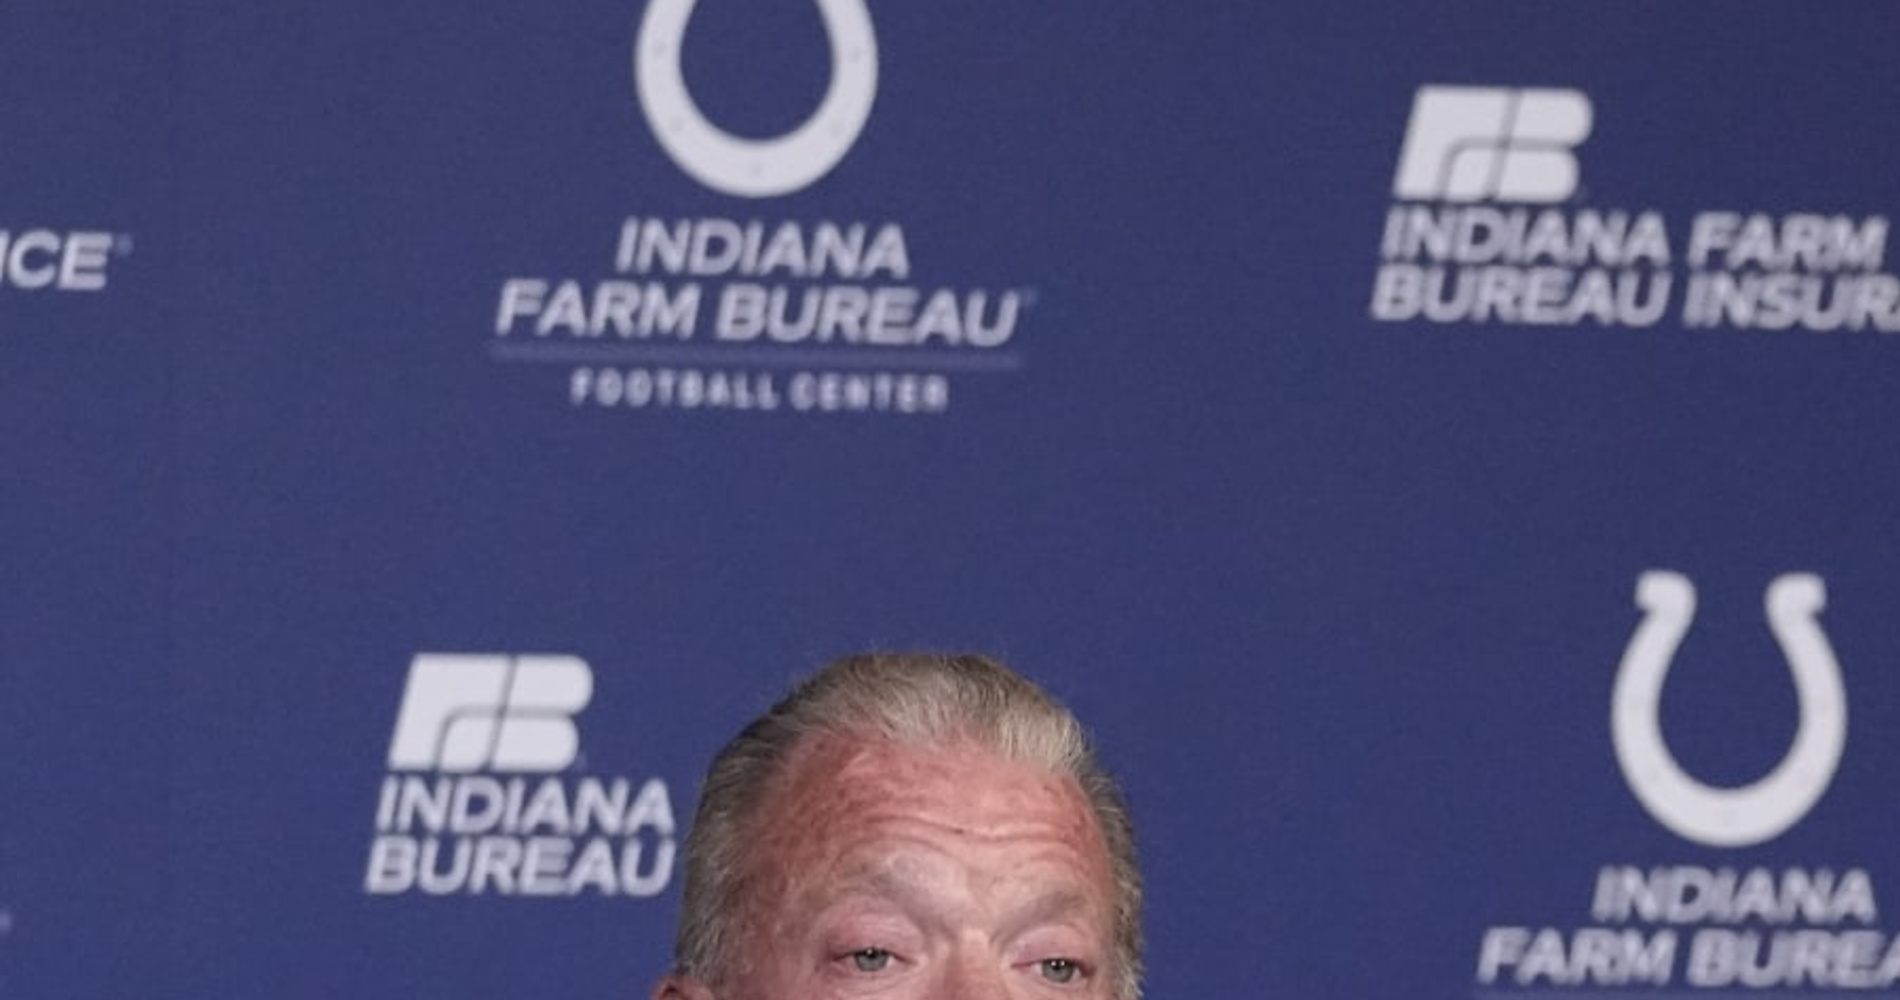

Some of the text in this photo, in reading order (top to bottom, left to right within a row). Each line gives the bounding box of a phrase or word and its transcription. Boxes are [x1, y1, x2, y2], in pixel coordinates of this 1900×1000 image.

[0, 230, 112, 290] CE
[615, 216, 910, 279] INDIANA
[1381, 205, 1890, 272] INDIANA FARM
[495, 277, 1019, 347] FARM BUREAU
[1370, 265, 1671, 326] BUREAU
[569, 366, 950, 413] FOOTBALL CENTER
[376, 775, 676, 835] INDIANA
[364, 835, 677, 896] BUREAU
[1591, 863, 1878, 925] INDIANA
[1476, 925, 1678, 988] FARM
